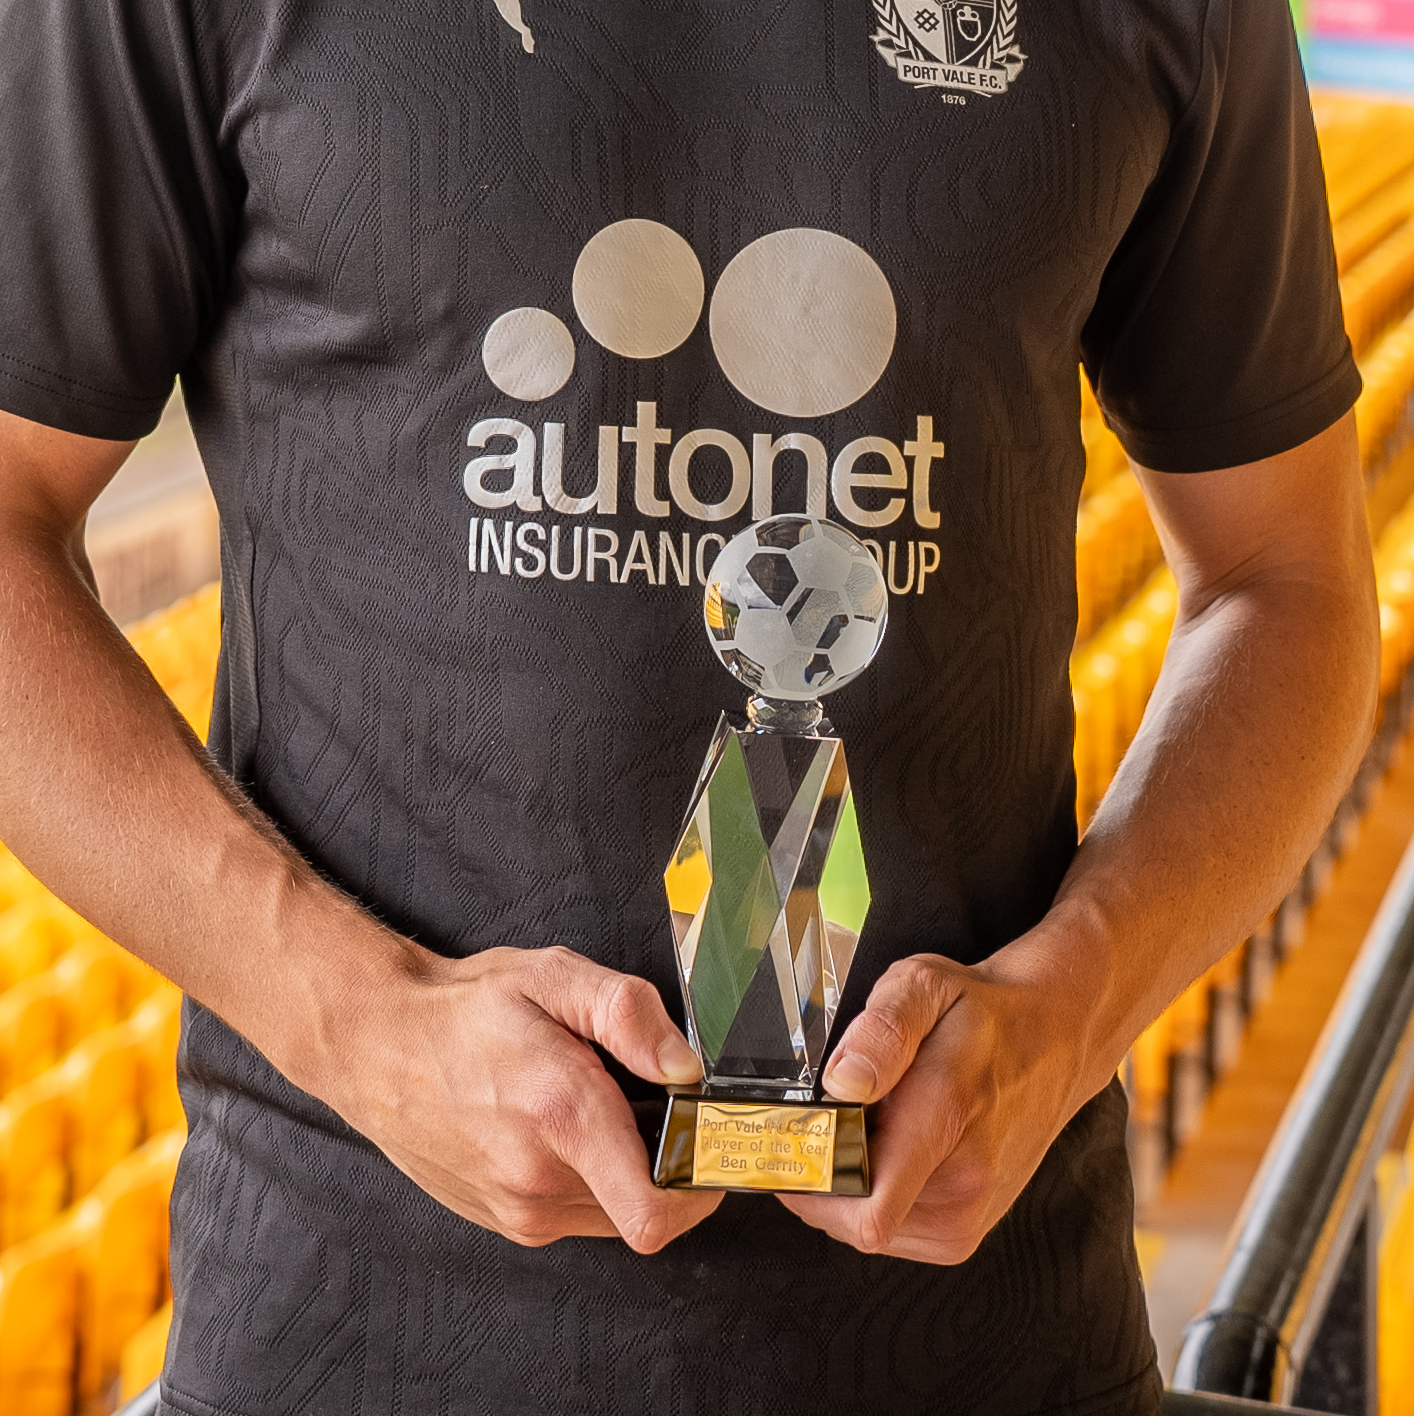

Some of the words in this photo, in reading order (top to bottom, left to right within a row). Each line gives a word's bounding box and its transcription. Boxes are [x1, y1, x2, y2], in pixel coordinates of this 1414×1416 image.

[902, 64, 939, 81] PORT
[941, 68, 977, 86] VALE
[979, 73, 1003, 90] F.C.
[940, 93, 967, 106] 1876
[462, 400, 945, 530] autonet
[467, 516, 728, 587] INSURANC
[701, 1117, 729, 1133] Port
[734, 1120, 764, 1134] Vale
[701, 1136, 744, 1153] Player
[749, 1139, 764, 1153] of
[770, 1141, 792, 1154] the
[797, 1140, 829, 1156] Year
[720, 1155, 747, 1170] Ben
[754, 1156, 807, 1175] Garrity
